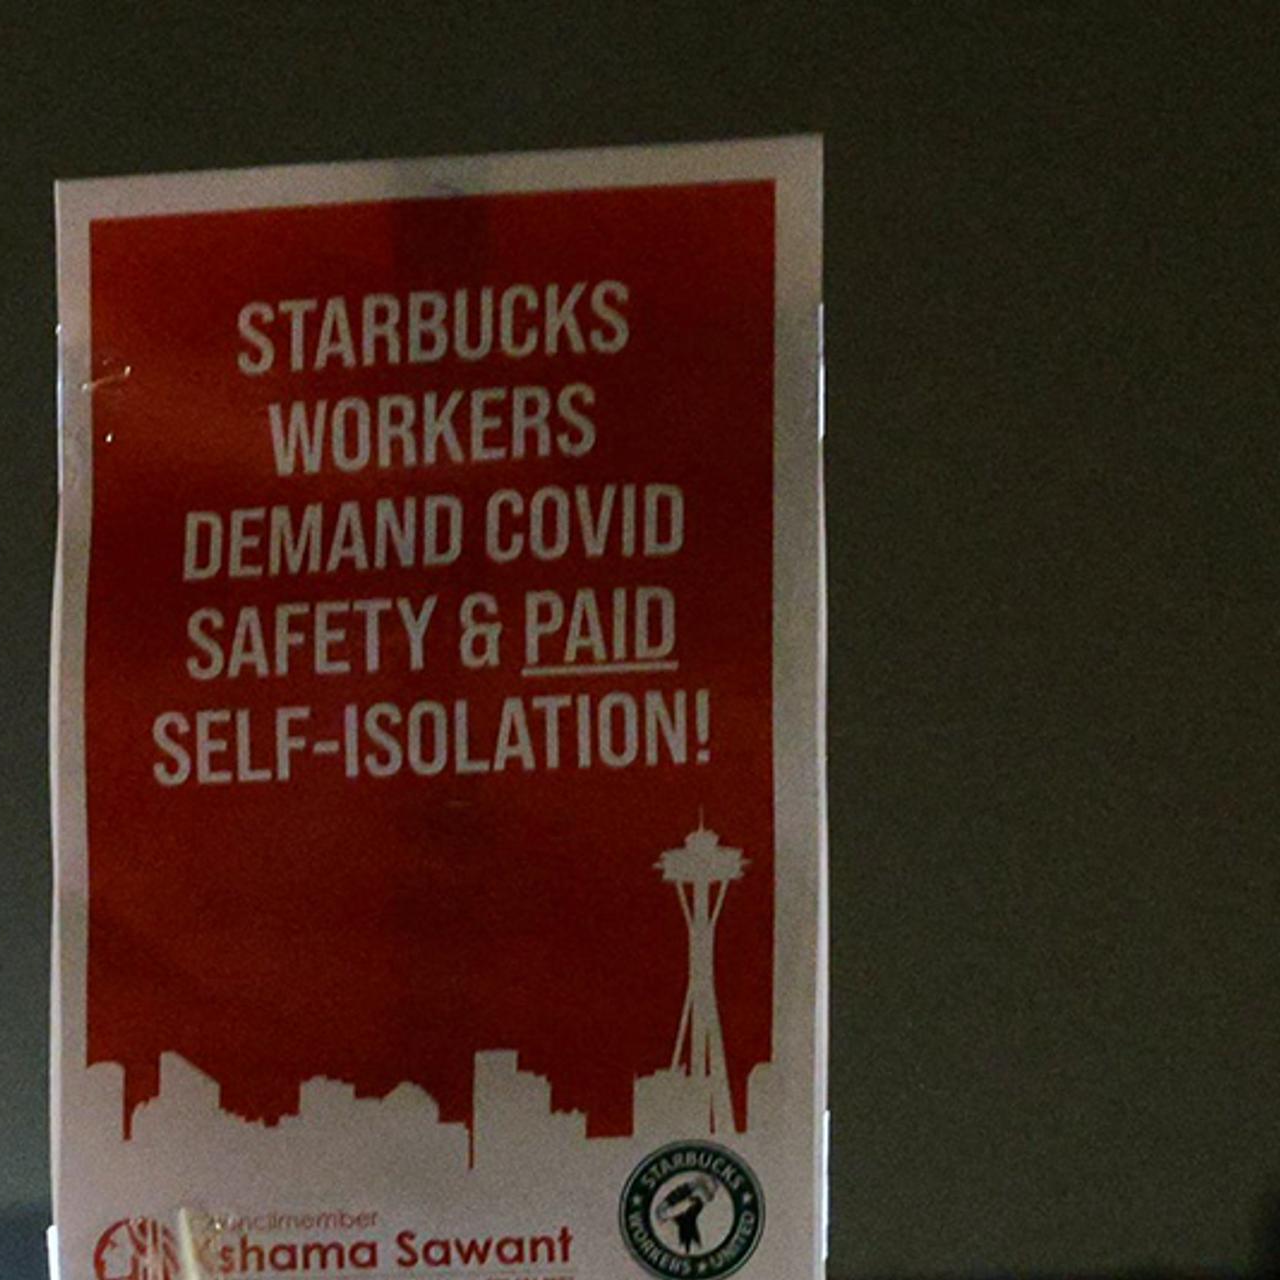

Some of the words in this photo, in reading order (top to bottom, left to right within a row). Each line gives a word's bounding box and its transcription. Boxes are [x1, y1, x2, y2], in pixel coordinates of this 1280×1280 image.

[237, 280, 630, 376] STARBUCKS
[268, 384, 596, 477] WORKERS
[183, 495, 463, 581] DEMAND
[485, 484, 685, 563] COVID
[186, 596, 437, 680] SAFETY
[459, 592, 502, 668] &
[525, 587, 679, 666] PAID
[152, 689, 711, 787] SELF-ISOLATION!
[639, 1150, 746, 1190] STARBUCKS
[396, 1225, 574, 1268] Sawant
[627, 1212, 692, 1276] WORKERS
